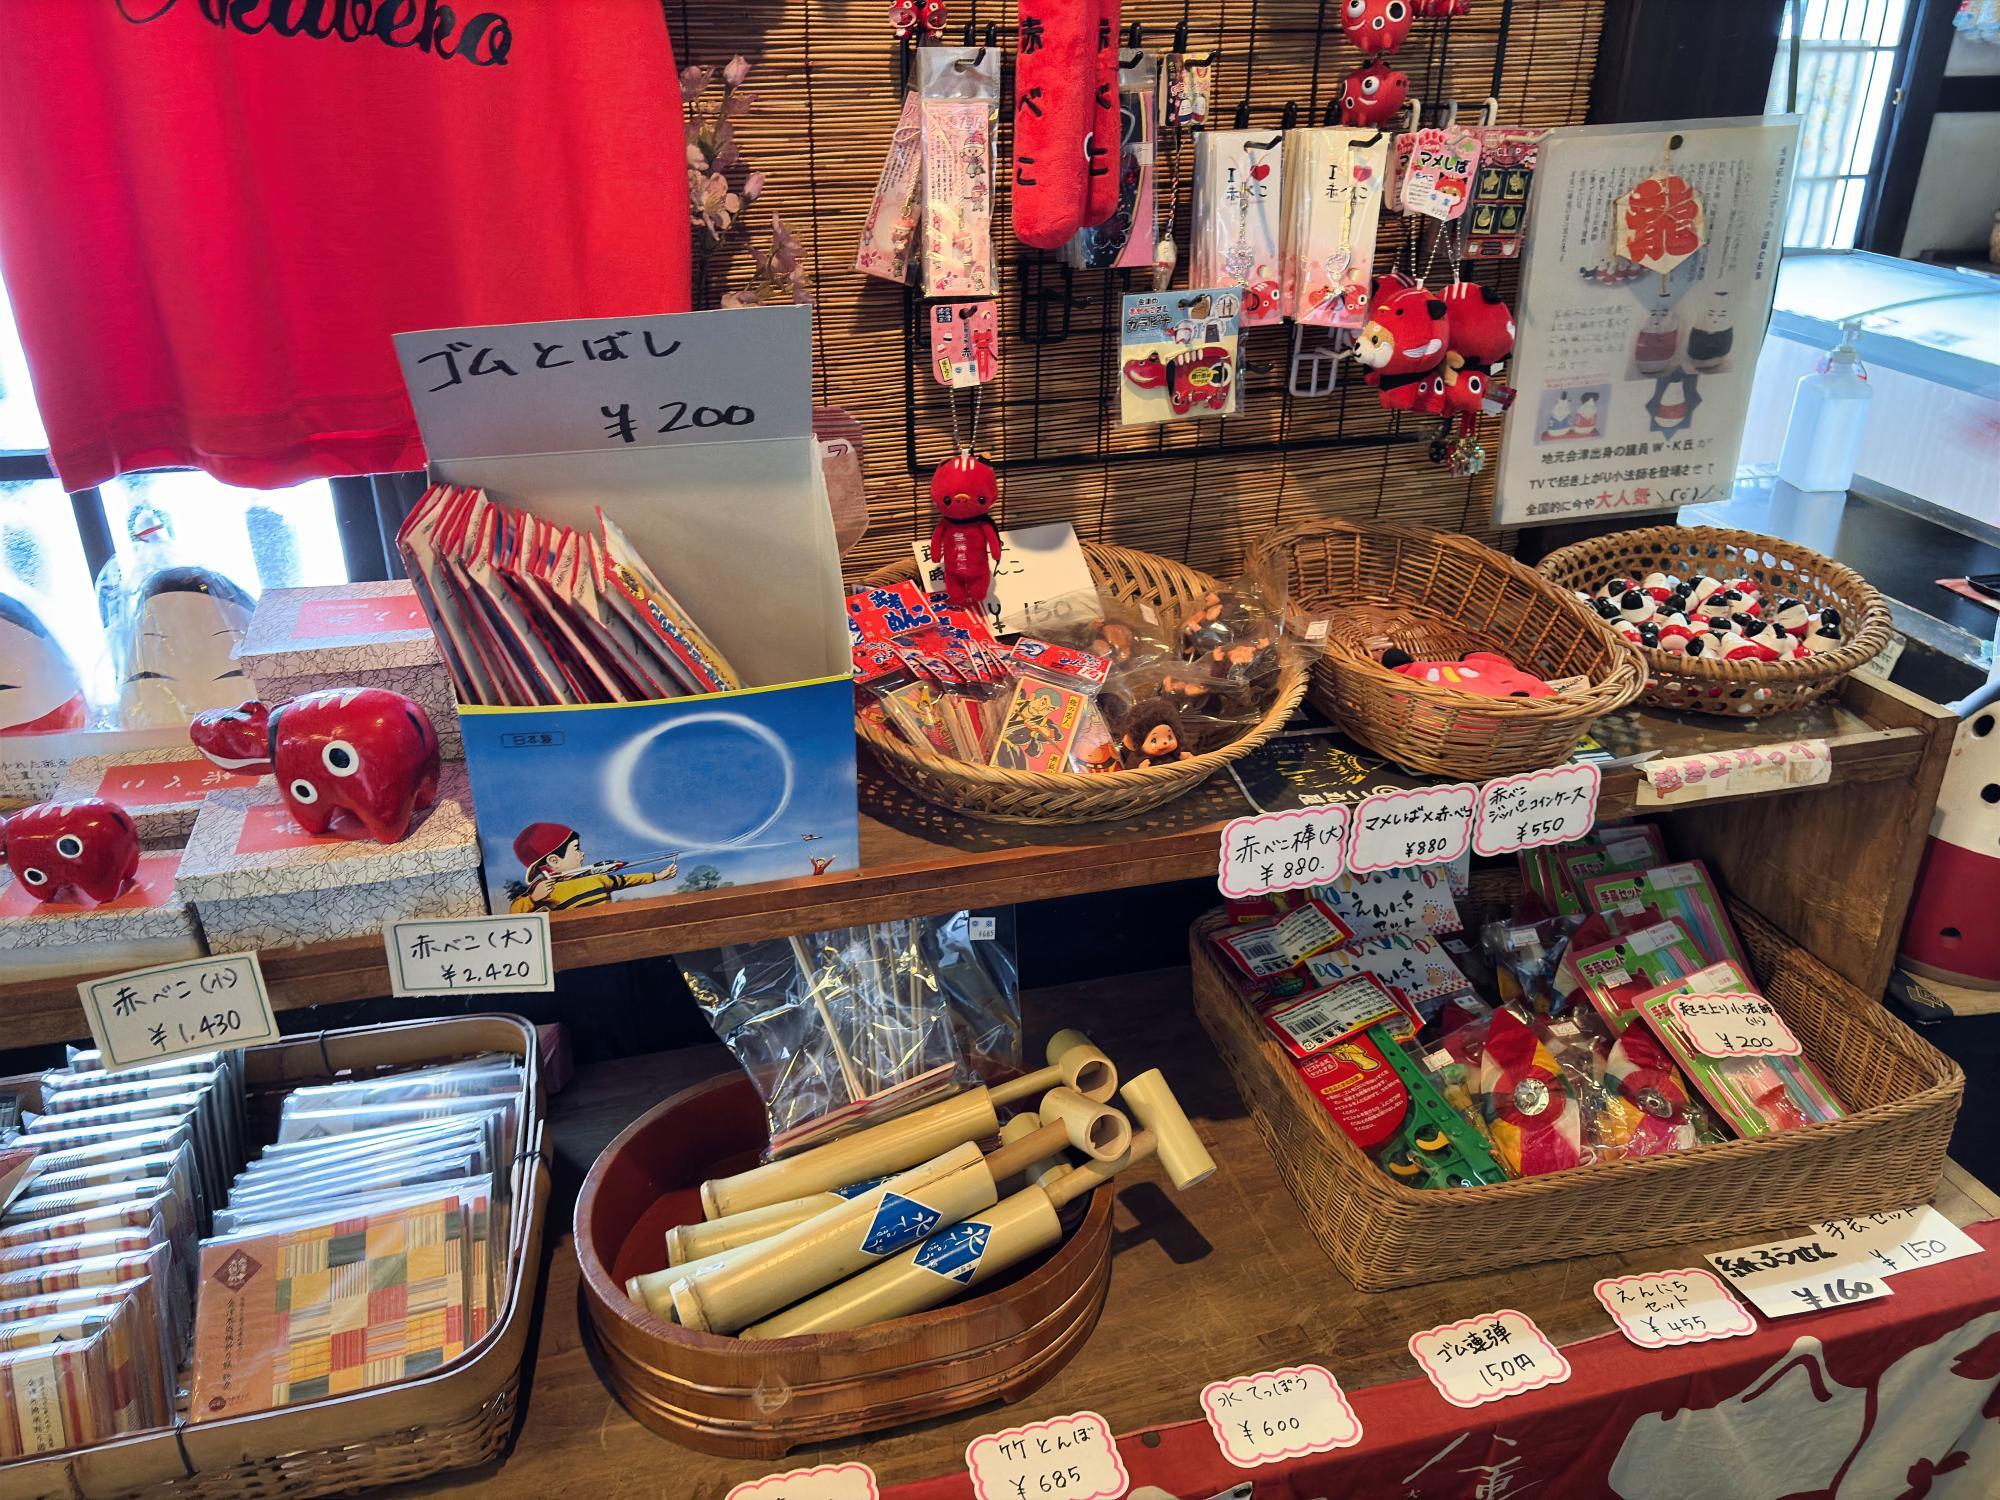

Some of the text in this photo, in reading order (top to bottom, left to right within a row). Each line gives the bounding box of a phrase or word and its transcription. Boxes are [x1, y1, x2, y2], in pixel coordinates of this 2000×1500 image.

[112, 0, 511, 67] kabeko
[417, 331, 682, 393] ゴムとばし
[1516, 817, 1565, 843] ¥550
[1405, 837, 1447, 858] ¥880
[1715, 1032, 1774, 1051] ¥200
[1868, 1239, 1947, 1271] ¥150
[1615, 1280, 1688, 1304] えんにち
[1644, 1294, 1689, 1313] セット
[1791, 1278, 1874, 1310] ¥160
[1639, 1315, 1707, 1337] ¥455
[1479, 1353, 1536, 1387] 150円
[1236, 1417, 1300, 1445] ¥600
[1009, 1466, 1082, 1500] ¥685
